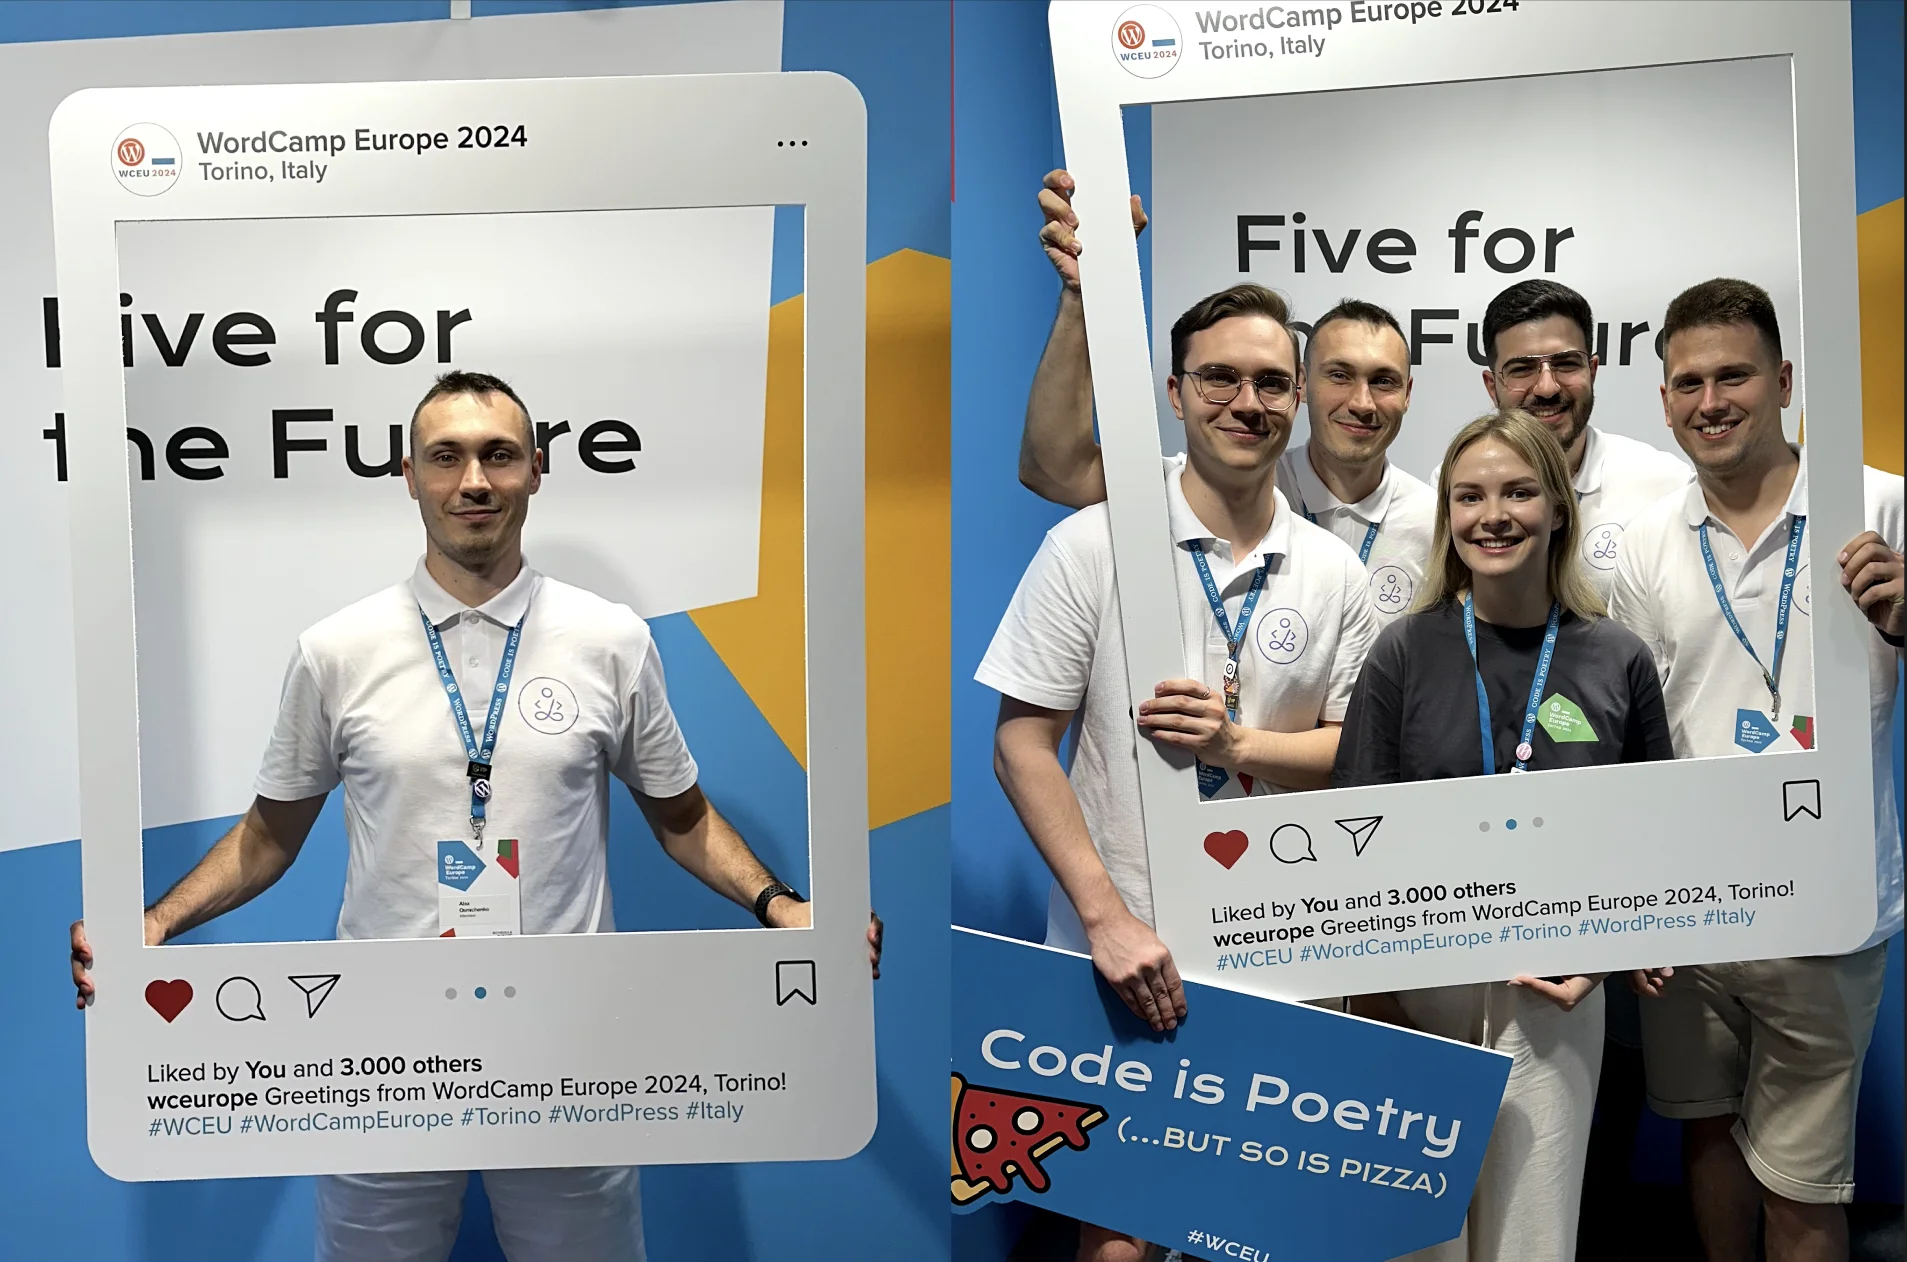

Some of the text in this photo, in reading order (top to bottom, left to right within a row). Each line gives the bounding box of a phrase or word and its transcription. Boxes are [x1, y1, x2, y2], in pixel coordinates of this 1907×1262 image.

[1195, 6, 1342, 33] WordCamp
[1350, 0, 1442, 24] Europe
[1120, 50, 1177, 61] WCEU 2024
[1198, 35, 1326, 60] Torino, Italy
[197, 125, 527, 157] WordCamp Europe 2024
[119, 169, 176, 178] WCEU 2024
[198, 160, 327, 183] Torino, Italy
[1236, 210, 1575, 274] Five for
[315, 288, 473, 365] for
[272, 408, 642, 479] Fure
[1788, 535, 1799, 562] POETRY
[1203, 572, 1211, 581] IS
[1207, 581, 1219, 603] CODE
[425, 620, 437, 640] CODE
[432, 641, 440, 650] IS
[502, 658, 512, 678] CODE
[507, 648, 514, 657] IS
[1531, 648, 1551, 708] CODE IS POETRY
[1549, 717, 1570, 727] Europe
[1550, 711, 1582, 726] WordCamp
[1741, 729, 1771, 737] WordCamp
[1211, 880, 1517, 924] Liked by You and 3.000 others
[1213, 880, 1795, 948] wceurope Greetings from WordCamp Europe 2024, Torino!
[1216, 907, 1756, 971] #WCEU #WordCampEurope #Torino #WordPress #Italy
[147, 1055, 483, 1085] Liked by You and 3.000 others
[147, 1072, 787, 1111] wceurope Greetings from WordCamp Europe 2024, Torino!
[981, 1028, 1462, 1159] Code is Poetry
[148, 1100, 744, 1137] #WCEU #WordCampEurope #Torino #WordPress #Italy
[1117, 1115, 1448, 1199] (...BUT SO IS PIZZA)
[1187, 1229, 1270, 1262] #WCEU
